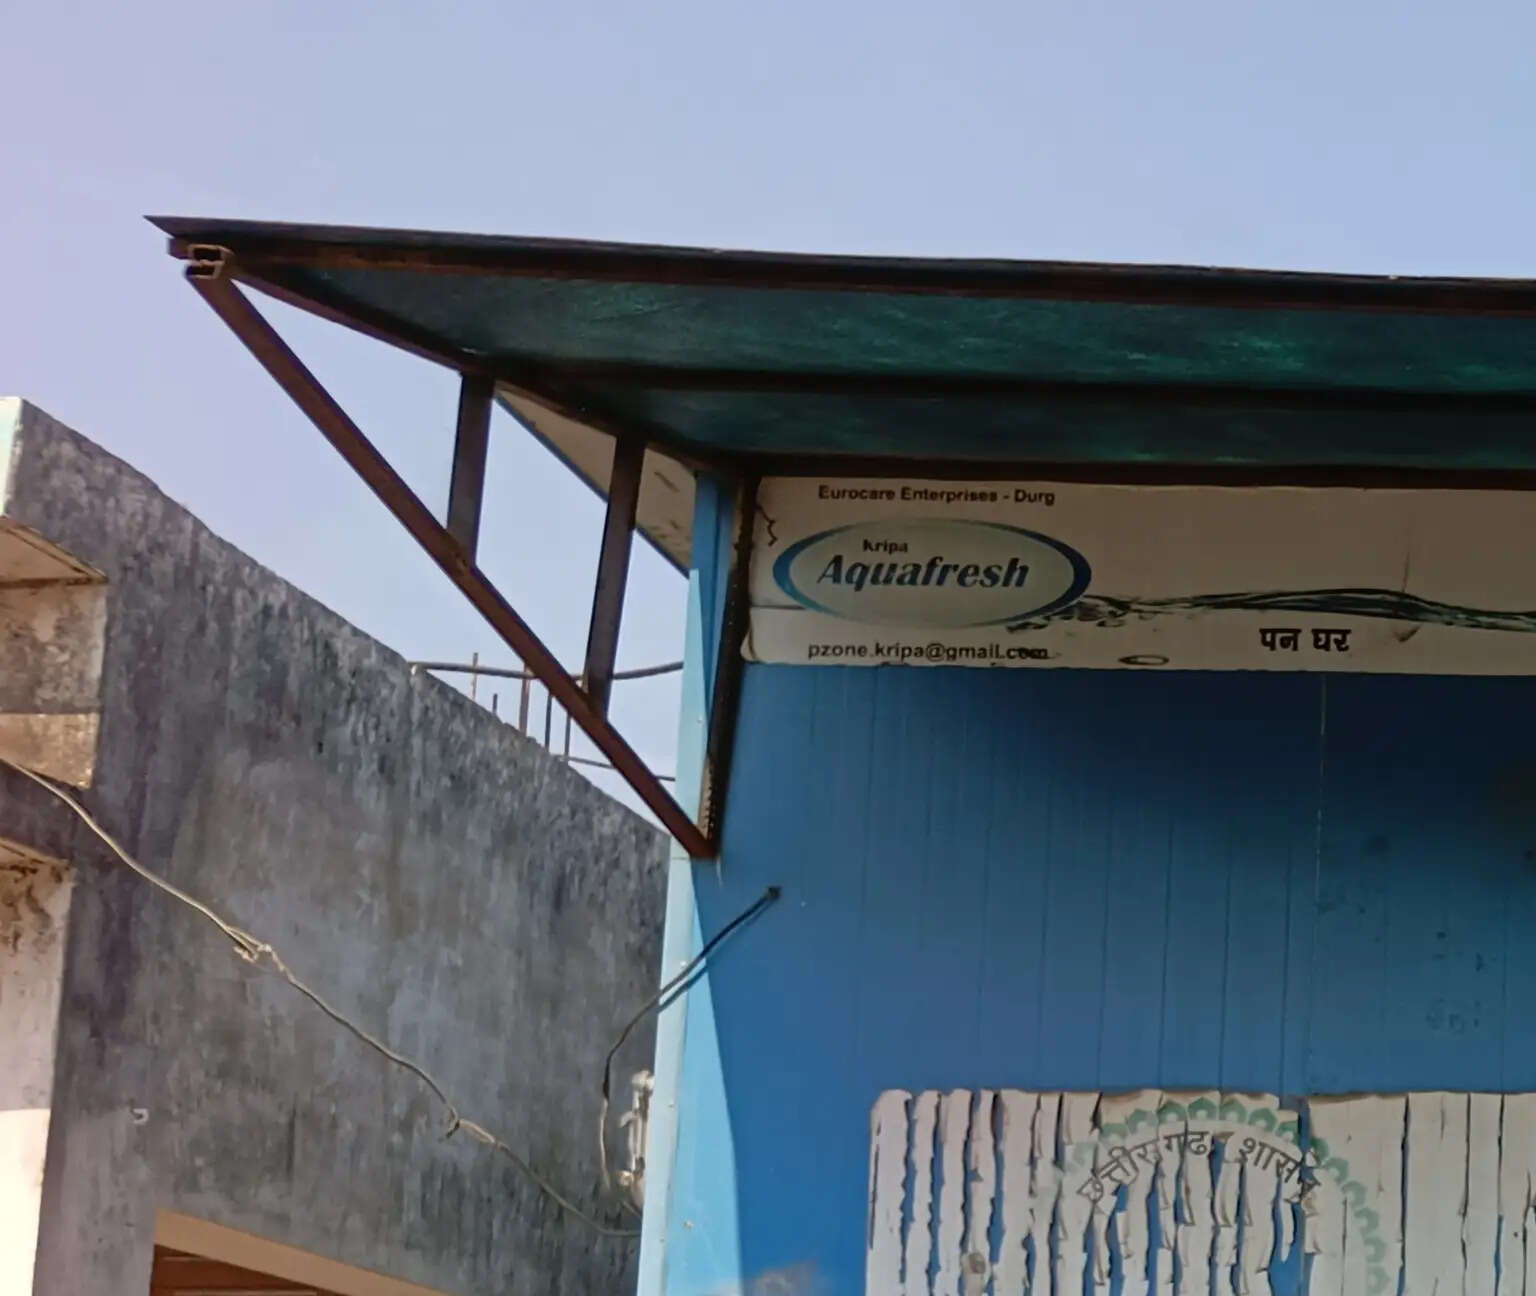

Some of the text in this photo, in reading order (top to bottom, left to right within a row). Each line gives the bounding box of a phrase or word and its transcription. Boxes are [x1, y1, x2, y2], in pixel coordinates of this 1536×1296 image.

[818, 485, 895, 501] Eurocare
[900, 487, 998, 503] Enterprises
[1014, 489, 1056, 505] Durg
[817, 554, 1031, 592] Aquafresh
[1259, 628, 1351, 652] पन घर
